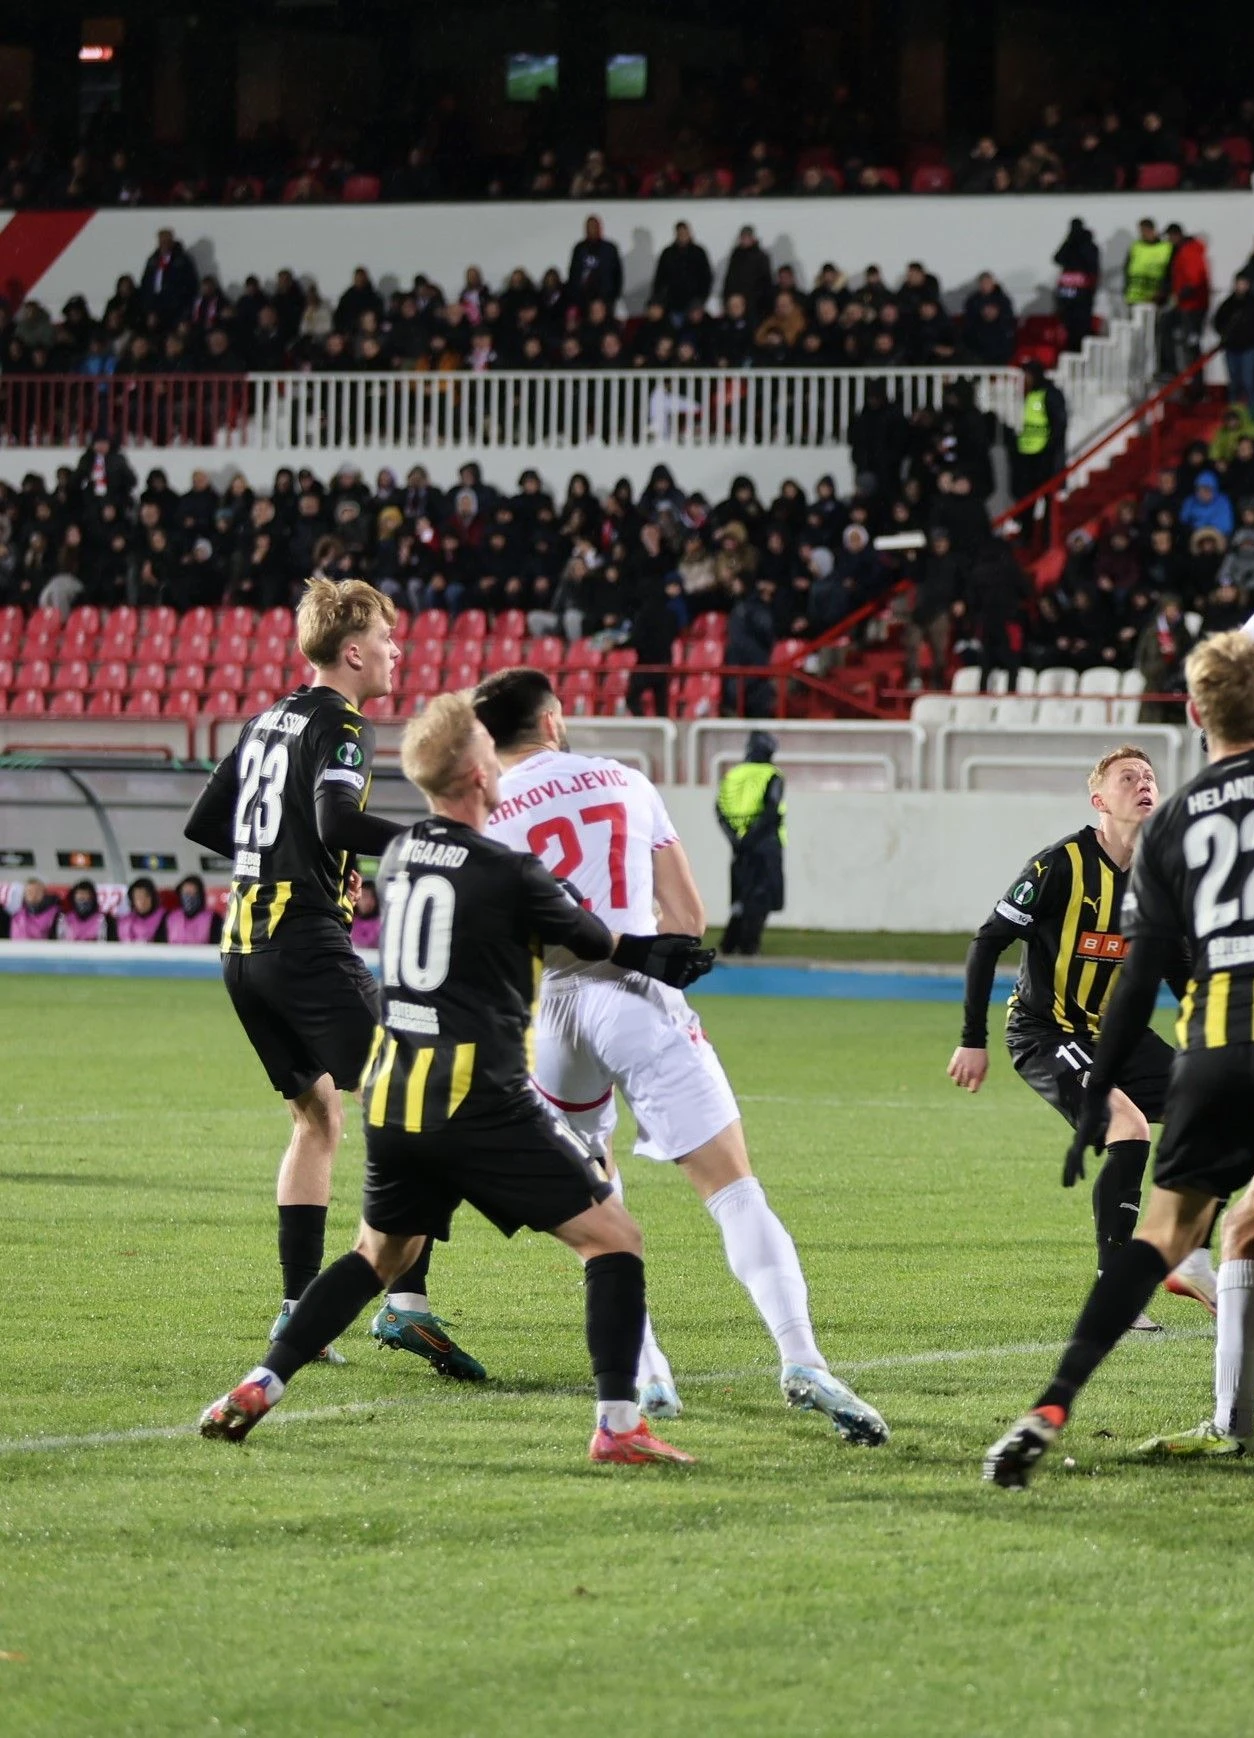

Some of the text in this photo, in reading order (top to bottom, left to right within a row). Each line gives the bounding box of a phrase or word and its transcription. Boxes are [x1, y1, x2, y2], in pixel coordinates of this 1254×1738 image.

[233, 739, 290, 848] 23
[526, 801, 628, 912] 27
[382, 871, 456, 992] 10
[1055, 1041, 1095, 1071] 11
